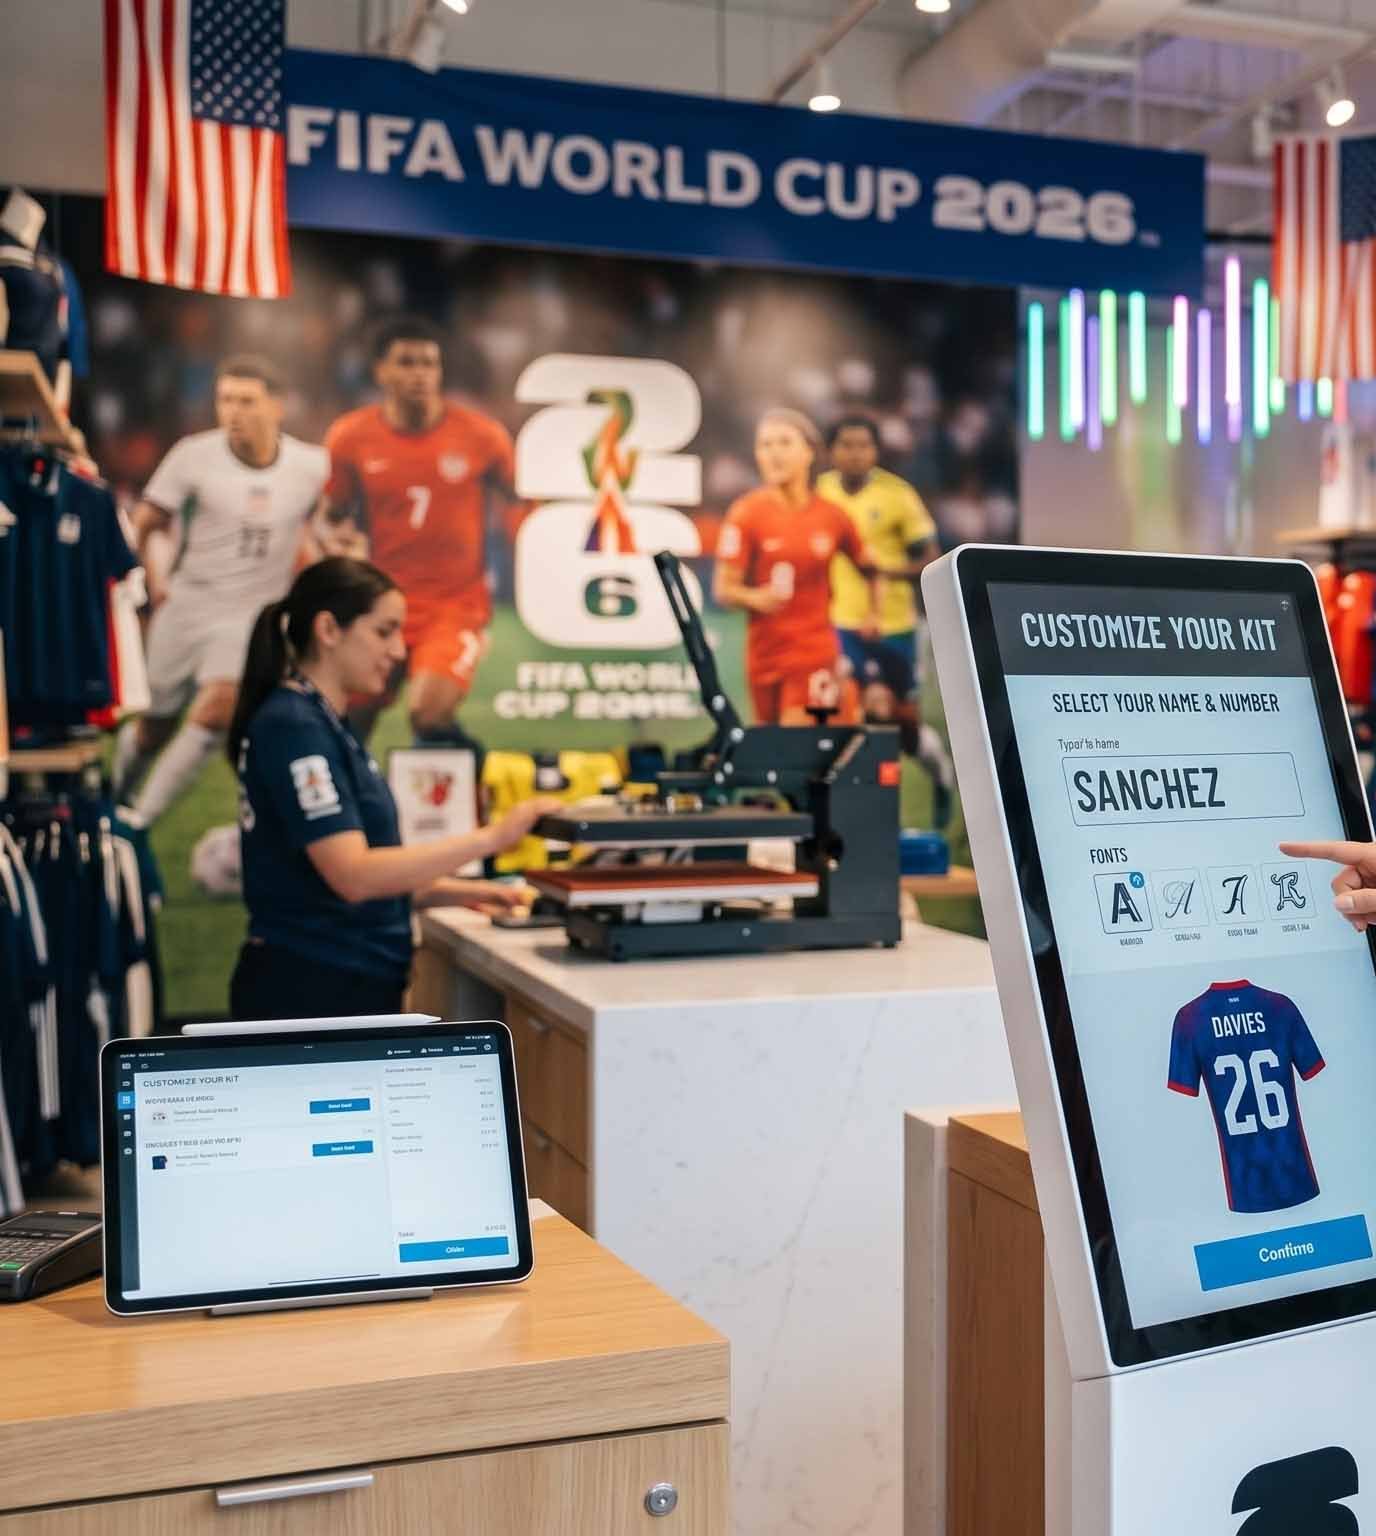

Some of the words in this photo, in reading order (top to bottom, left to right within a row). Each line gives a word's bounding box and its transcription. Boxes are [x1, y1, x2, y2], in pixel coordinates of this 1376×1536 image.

[286, 104, 465, 182] FIFA
[474, 124, 762, 208] WORLD
[774, 157, 921, 223] CUP
[931, 174, 1136, 246] 2026
[406, 486, 431, 529] 7
[1021, 613, 1166, 649] CUSTOMIZE
[1169, 616, 1236, 650] YOUR
[1238, 619, 1277, 651] KIT
[1052, 693, 1108, 713] SELECT
[1114, 693, 1154, 713] YOUR
[1159, 693, 1201, 713] NAME
[1205, 693, 1217, 713] &
[1219, 693, 1280, 713] NUMBER
[1073, 767, 1226, 813] SANCHEZ
[1090, 848, 1128, 864] FONTS
[1111, 882, 1143, 924] A
[1211, 1012, 1266, 1038] DAVIES
[143, 1077, 197, 1088] CUSTOMIZE
[199, 1075, 224, 1084] YOUR
[225, 1074, 240, 1083] KIT
[1213, 1049, 1290, 1136] 26
